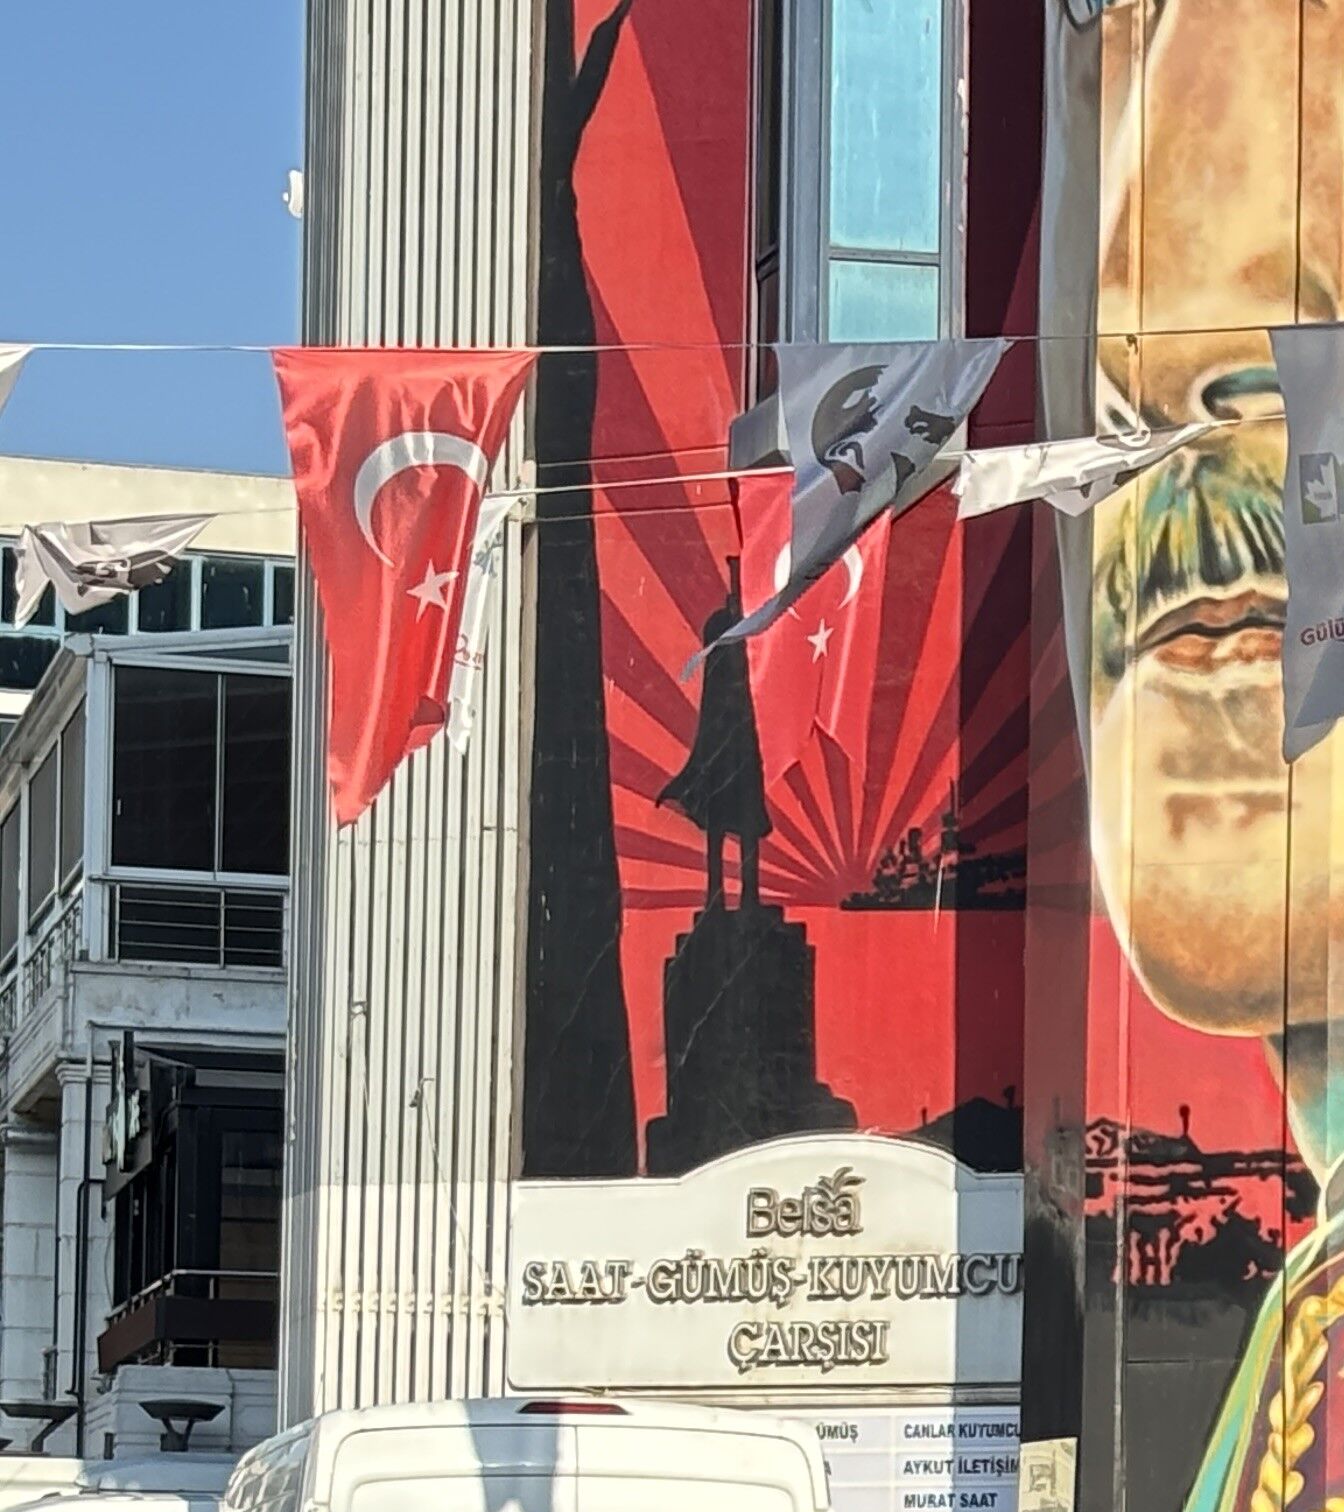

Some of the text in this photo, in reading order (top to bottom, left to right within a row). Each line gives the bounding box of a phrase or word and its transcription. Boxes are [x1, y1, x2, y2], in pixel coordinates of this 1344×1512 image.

[747, 1186, 864, 1238] Belsa
[727, 1319, 891, 1375] ÇARŞISI
[816, 1421, 859, 1443] ÜMÜŞ
[904, 1460, 952, 1475] AYKUT
[904, 1492, 998, 1508] MURAT SAAT
